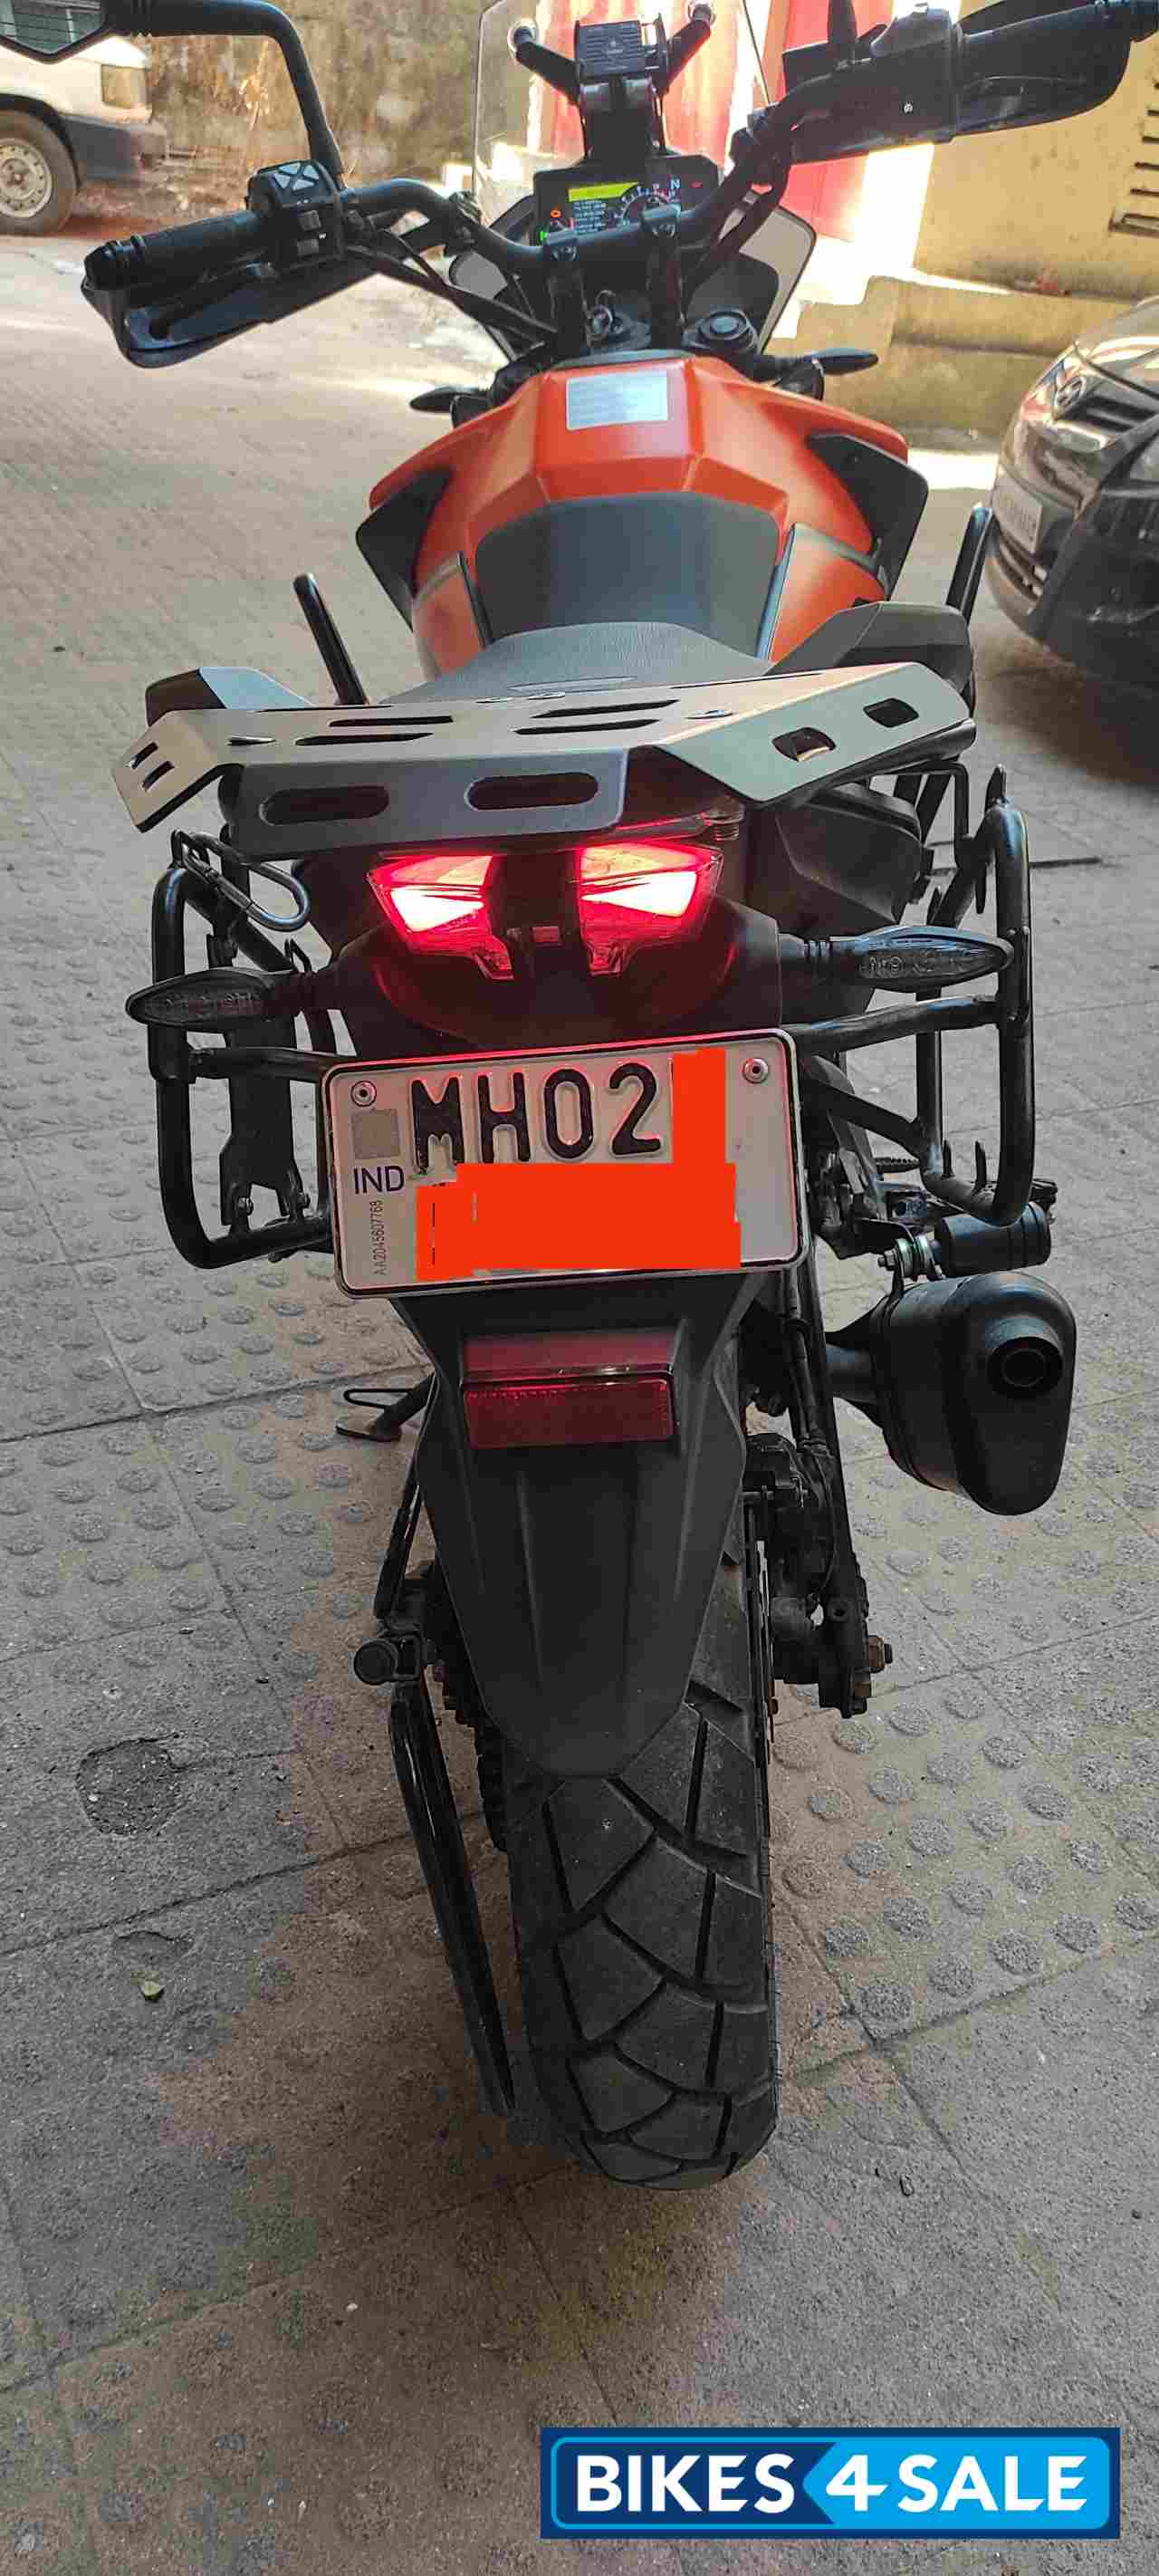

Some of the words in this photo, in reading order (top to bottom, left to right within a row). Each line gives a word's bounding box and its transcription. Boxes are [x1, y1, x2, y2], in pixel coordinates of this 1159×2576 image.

[670, 178, 681, 189] N
[410, 1062, 662, 1175] MH02
[353, 1166, 405, 1195] IND
